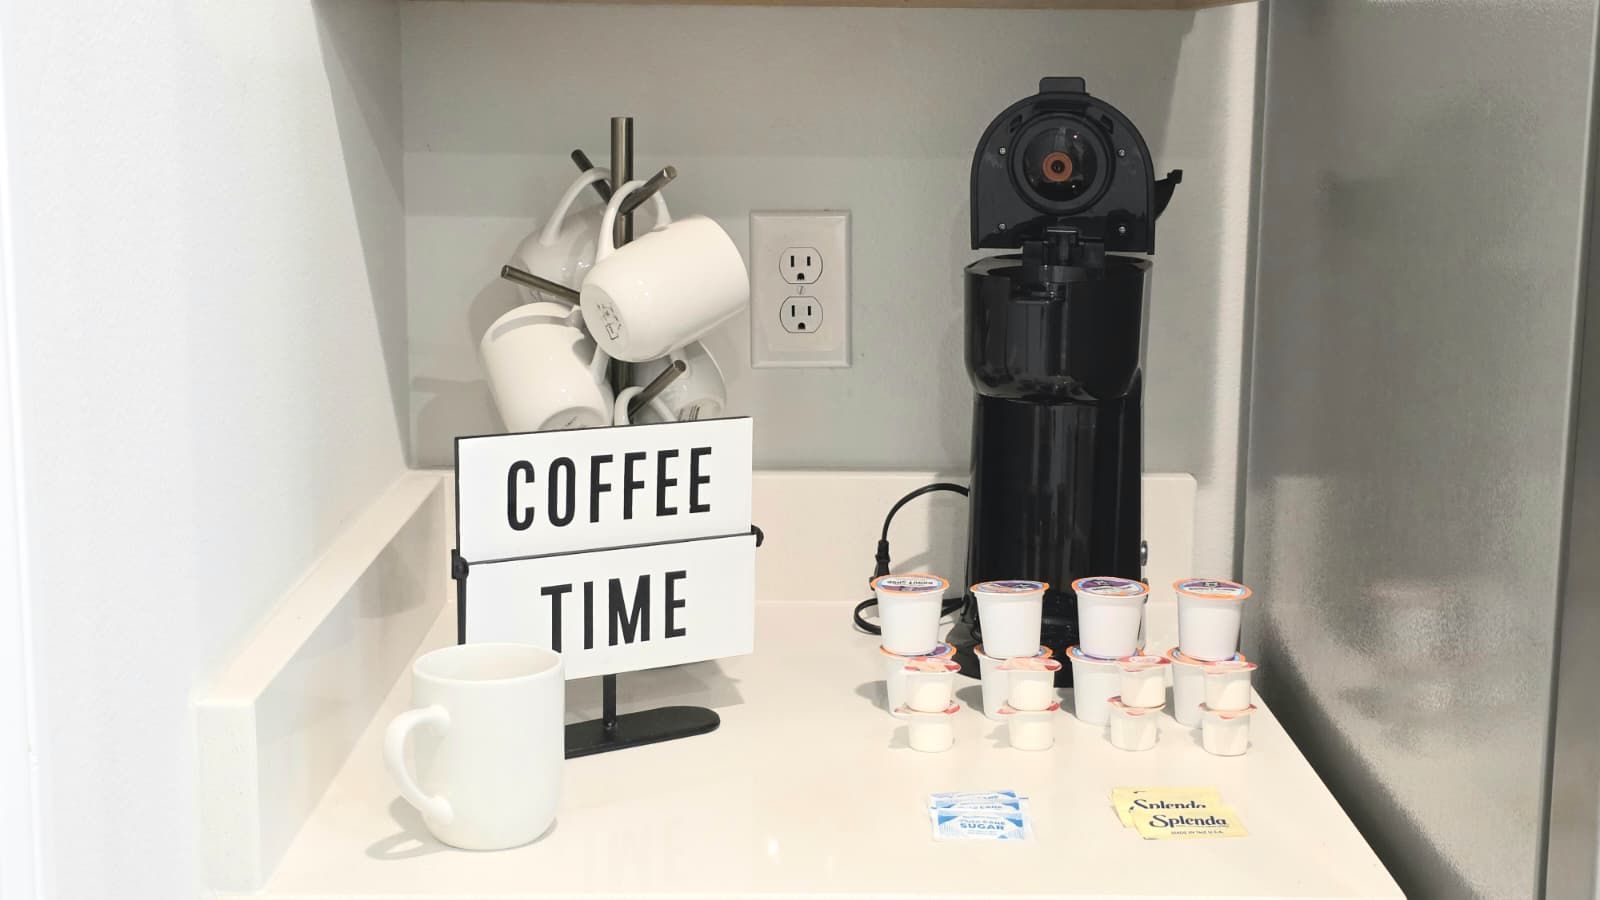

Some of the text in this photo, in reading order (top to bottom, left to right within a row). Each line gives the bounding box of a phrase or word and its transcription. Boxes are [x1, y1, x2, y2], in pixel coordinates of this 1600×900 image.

[507, 446, 712, 531] COFFEE
[540, 570, 687, 654] TIME
[960, 822, 1005, 831] SUGAR
[1149, 814, 1227, 828] Splenda
